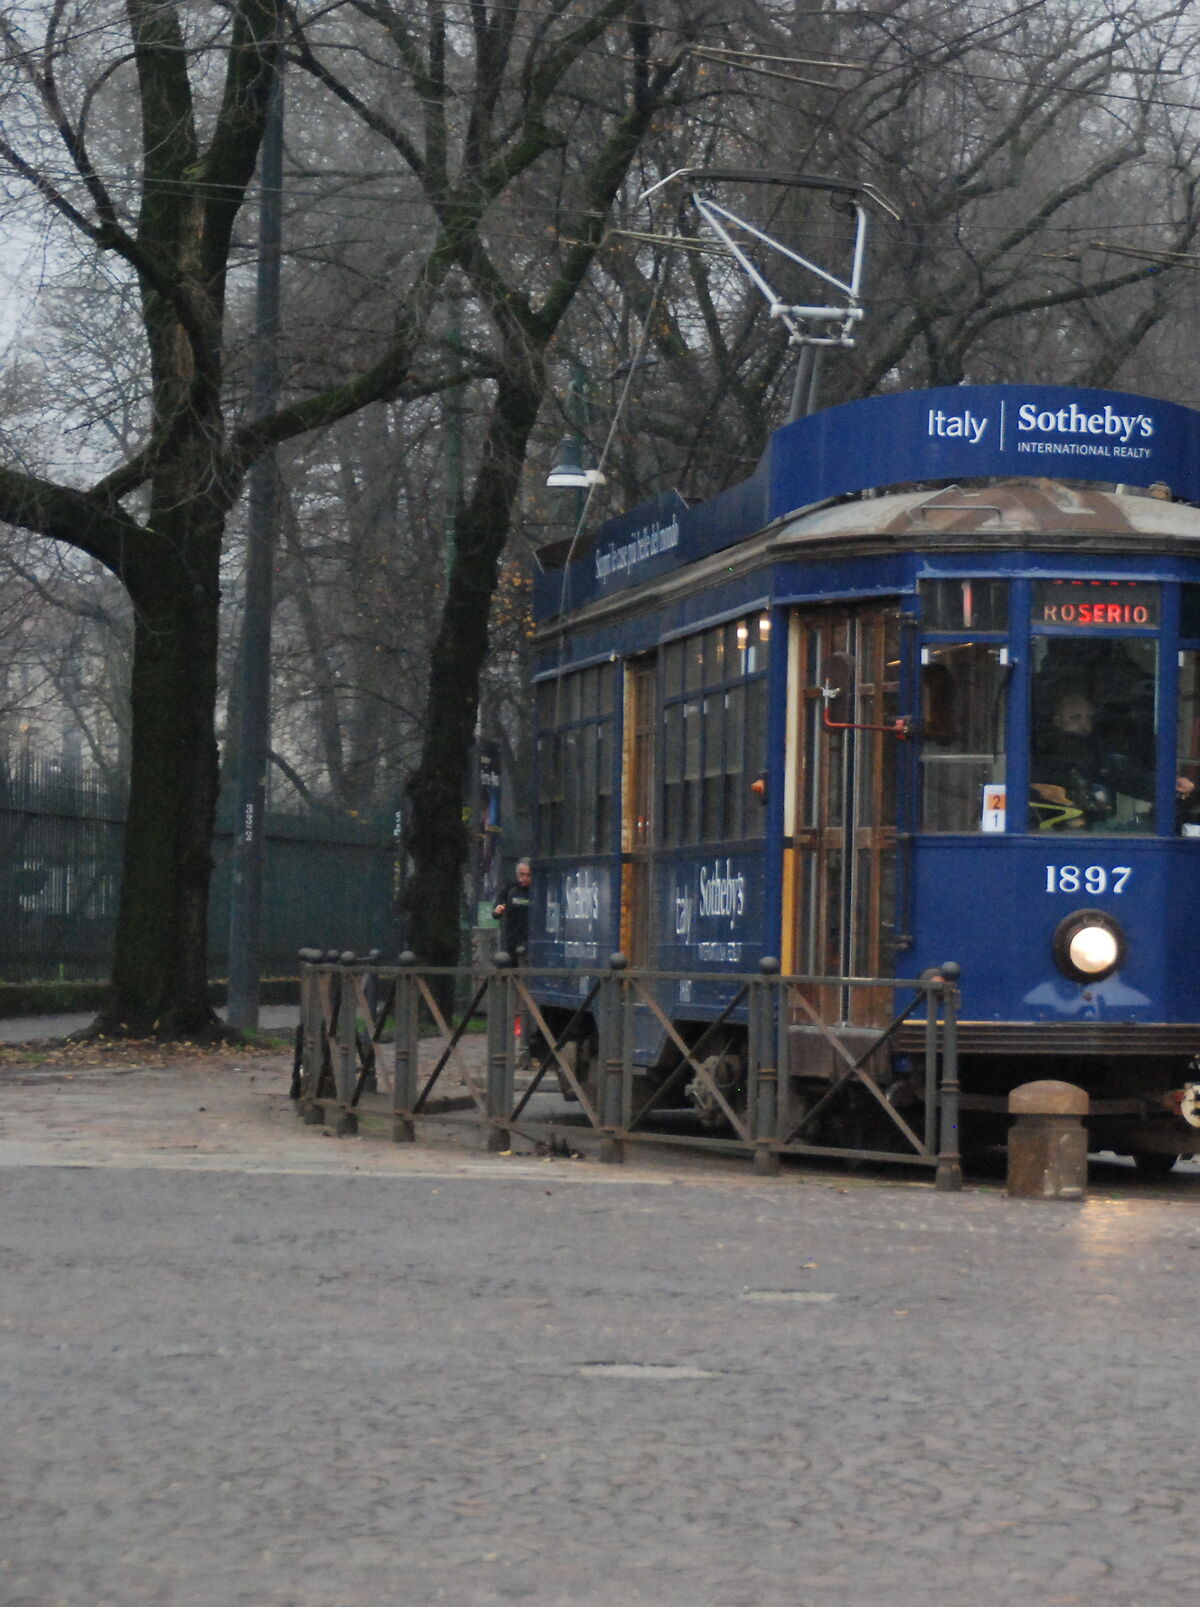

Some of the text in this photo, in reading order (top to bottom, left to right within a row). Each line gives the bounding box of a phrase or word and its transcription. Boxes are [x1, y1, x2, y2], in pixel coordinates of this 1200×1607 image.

[928, 403, 1153, 443] Italy Sotheby's
[1017, 441, 1151, 459] INTERNATIONAL REALTY
[1043, 603, 1148, 624] ROSERIO
[993, 795, 1000, 809] 2
[1046, 865, 1131, 894] 1897
[700, 858, 744, 930] Sotheby's
